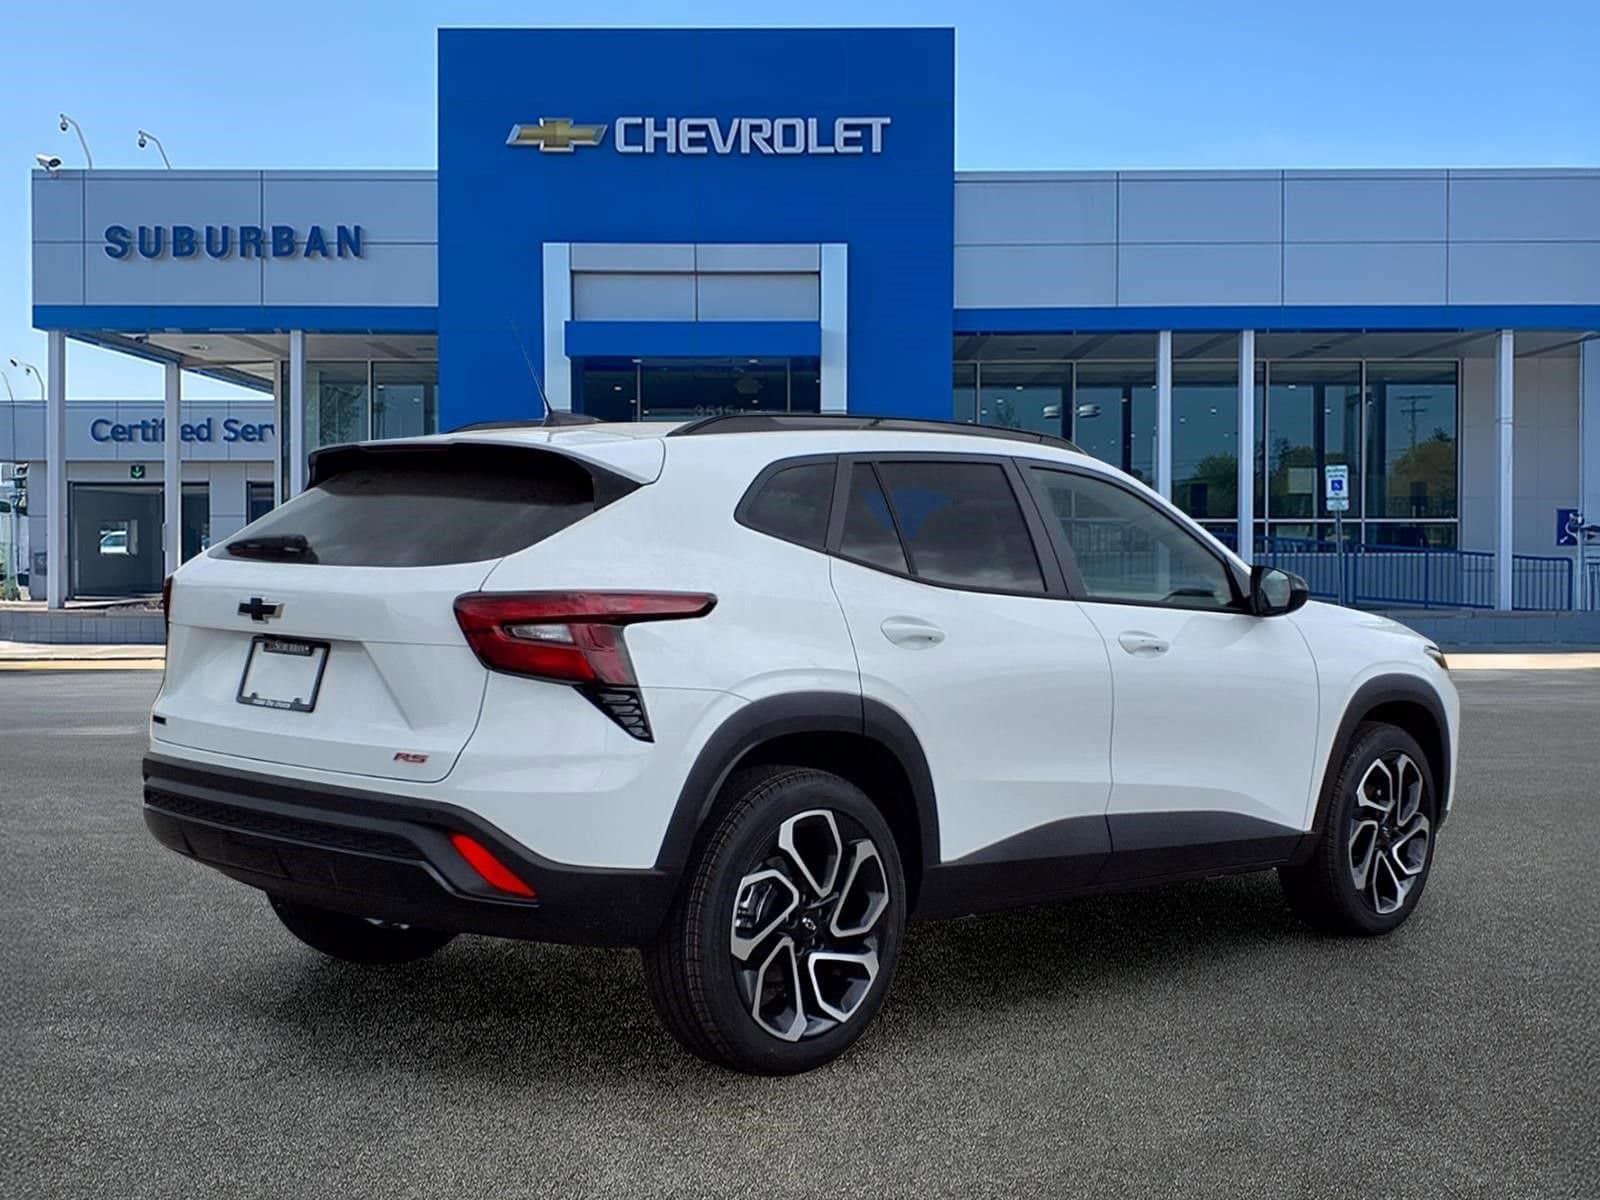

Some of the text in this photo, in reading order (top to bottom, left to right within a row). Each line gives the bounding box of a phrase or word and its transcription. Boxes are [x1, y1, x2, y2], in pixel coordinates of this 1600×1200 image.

[615, 117, 891, 154] CHEVROLET
[104, 225, 361, 258] SUBURBAN
[91, 417, 212, 442] Certifed
[393, 752, 429, 764] RS
